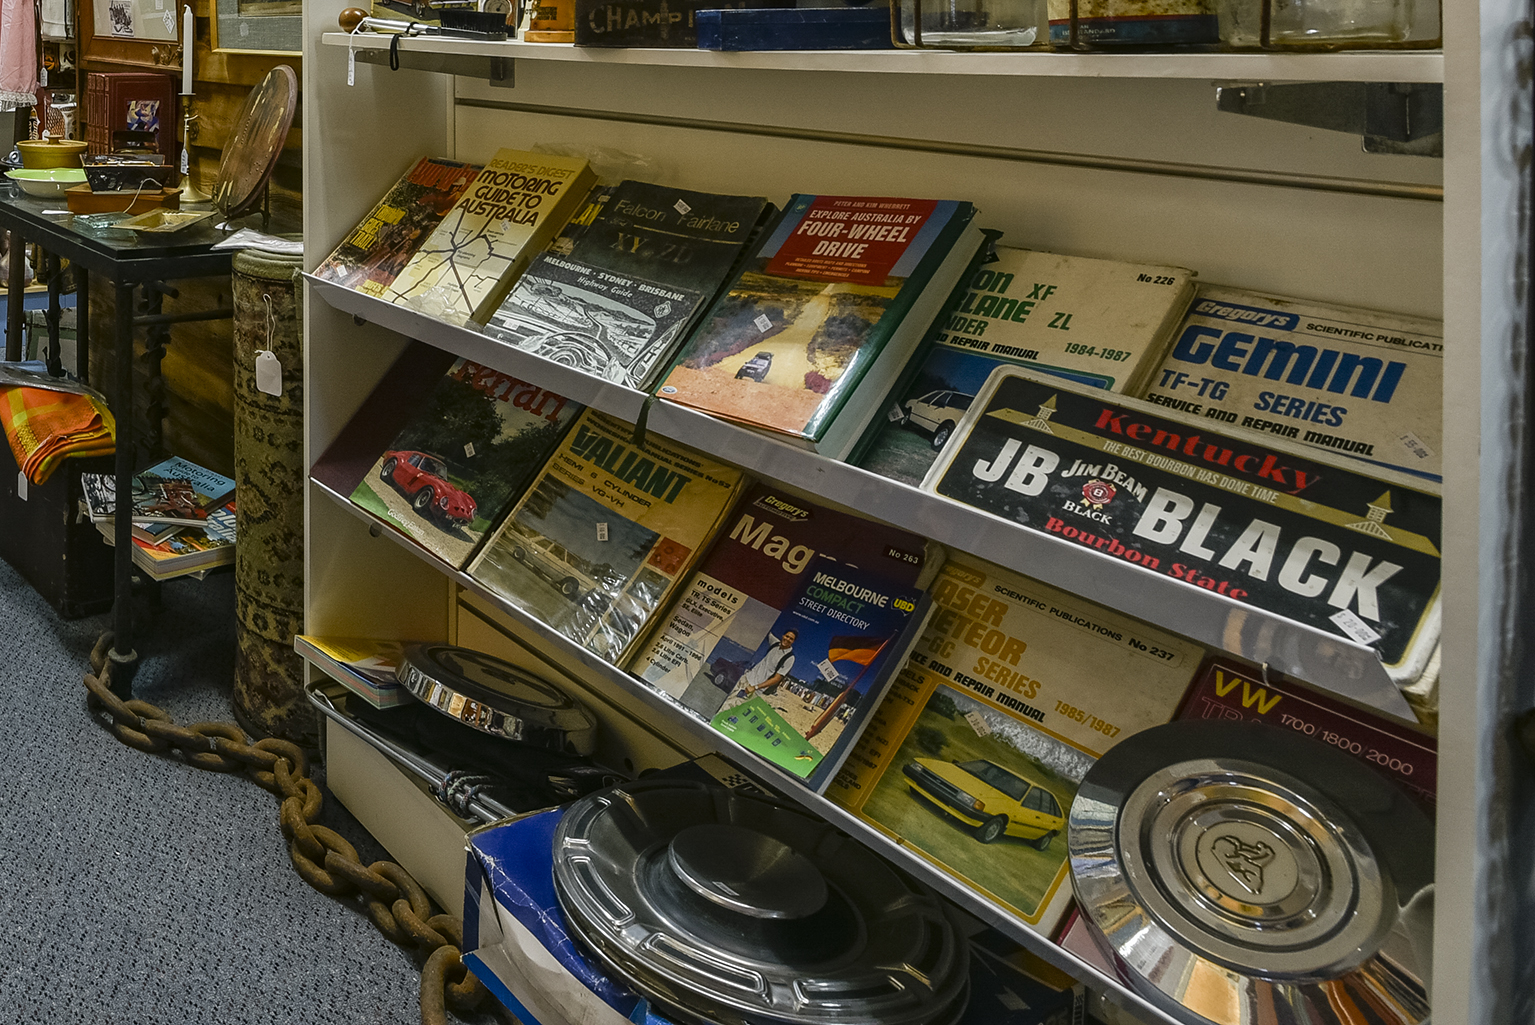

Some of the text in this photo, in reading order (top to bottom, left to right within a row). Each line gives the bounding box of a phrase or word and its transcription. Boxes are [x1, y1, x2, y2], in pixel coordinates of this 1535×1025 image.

[489, 158, 538, 175] READER'S
[536, 166, 575, 179] DIGEST
[476, 169, 564, 196] MOTORING
[475, 185, 543, 209] GUIDE TO
[455, 197, 539, 227] AUSTRALIA
[614, 199, 740, 234] Falcon Fairlane
[809, 209, 922, 225] EXPLORE AUSTRALIA BY
[797, 220, 911, 243] FOUR-WHEEL
[812, 240, 869, 259] DRIVE
[543, 255, 685, 302] MELBOURNE SYDNEY BRISBANE
[577, 276, 633, 299] Highway Guide
[1026, 283, 1058, 301] XF
[1137, 273, 1175, 286] No 226
[1047, 312, 1074, 331] ZL
[1194, 300, 1292, 328] Gregorys
[1306, 322, 1375, 341] SCIENTIFIC
[950, 335, 1040, 361] REPAIR MANUAL
[1064, 342, 1132, 363] 1984-1987
[1171, 324, 1407, 405] GEMINI
[1159, 368, 1348, 428] TF-TG SERIES
[1145, 392, 1203, 415] SERVICE
[1204, 408, 1238, 424] AND
[1241, 416, 1301, 440] REPAIR
[1303, 430, 1376, 457] MANUAL
[569, 424, 693, 505] VALIANT
[1094, 409, 1323, 495] Kentucky
[163, 468, 215, 492] Australia
[174, 462, 226, 486] Motoring
[558, 453, 652, 509] HEMI 6 CYLINDER
[673, 462, 705, 479] SERIES
[1061, 459, 1149, 504] JIM BEAM
[1103, 440, 1280, 503] THE BEST BOURBON HAS DONE TIME
[552, 462, 625, 508] SERIES VG-VH
[764, 494, 809, 518] Gregorys
[1062, 499, 1113, 526] BLACK
[972, 437, 1404, 623] JB BLACK
[888, 548, 919, 565] No 263
[1045, 516, 1249, 600] Bourbon State
[696, 579, 739, 604] models
[701, 595, 733, 615] TS Series
[806, 585, 865, 614] COMPACT
[813, 572, 916, 612] MELBOURNE UBD
[673, 615, 694, 631] Sedan,
[690, 607, 703, 618] Elite
[798, 597, 871, 631] STREET DIRECTORY
[994, 584, 1175, 662] SCIENTIFIC PUBLICATIONS No 237
[669, 621, 691, 638] Wagon
[660, 652, 671, 661] Litre
[664, 646, 675, 655] Litre
[650, 658, 671, 673] Cylinder
[972, 656, 1042, 700] SERIES
[928, 660, 953, 678] AND
[953, 672, 995, 698] REPAIR
[995, 692, 1046, 724] MANUAL
[1215, 670, 1283, 715] VW
[1053, 699, 1121, 739] 1985/1987
[1280, 712, 1414, 775] 1700/1800/2000
